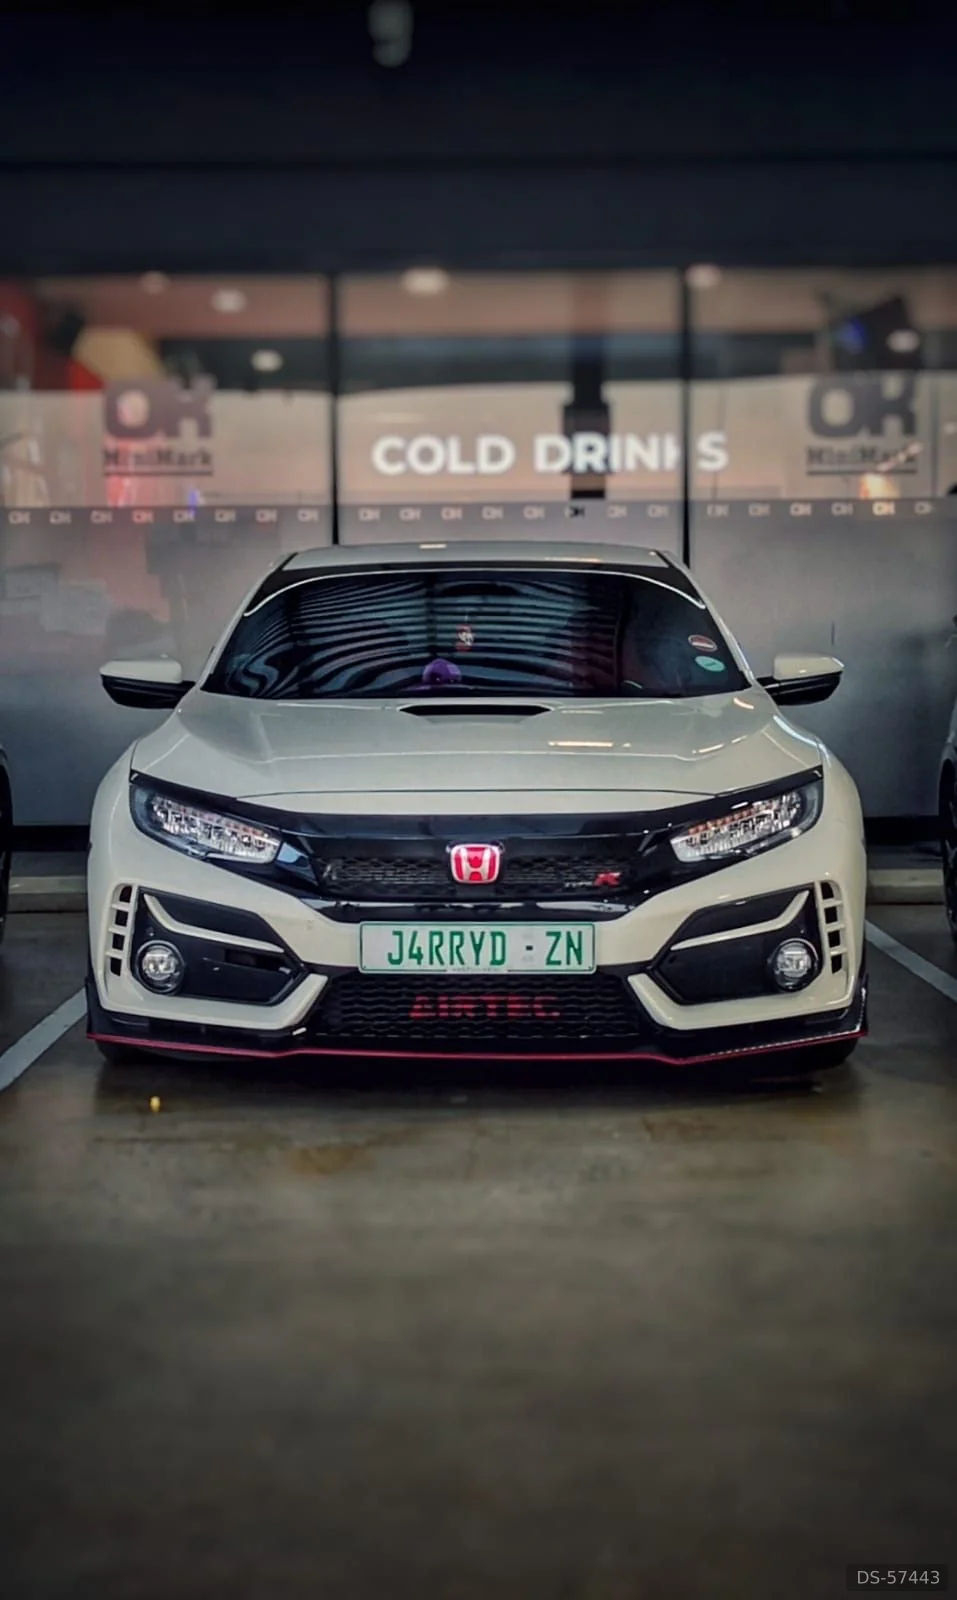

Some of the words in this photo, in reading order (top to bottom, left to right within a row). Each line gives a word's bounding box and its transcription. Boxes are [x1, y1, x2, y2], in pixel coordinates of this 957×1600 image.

[105, 374, 215, 438] OK
[808, 371, 917, 438] OK
[371, 435, 515, 474] COLD
[387, 930, 507, 966] J4RRYD
[545, 930, 583, 966] ZN
